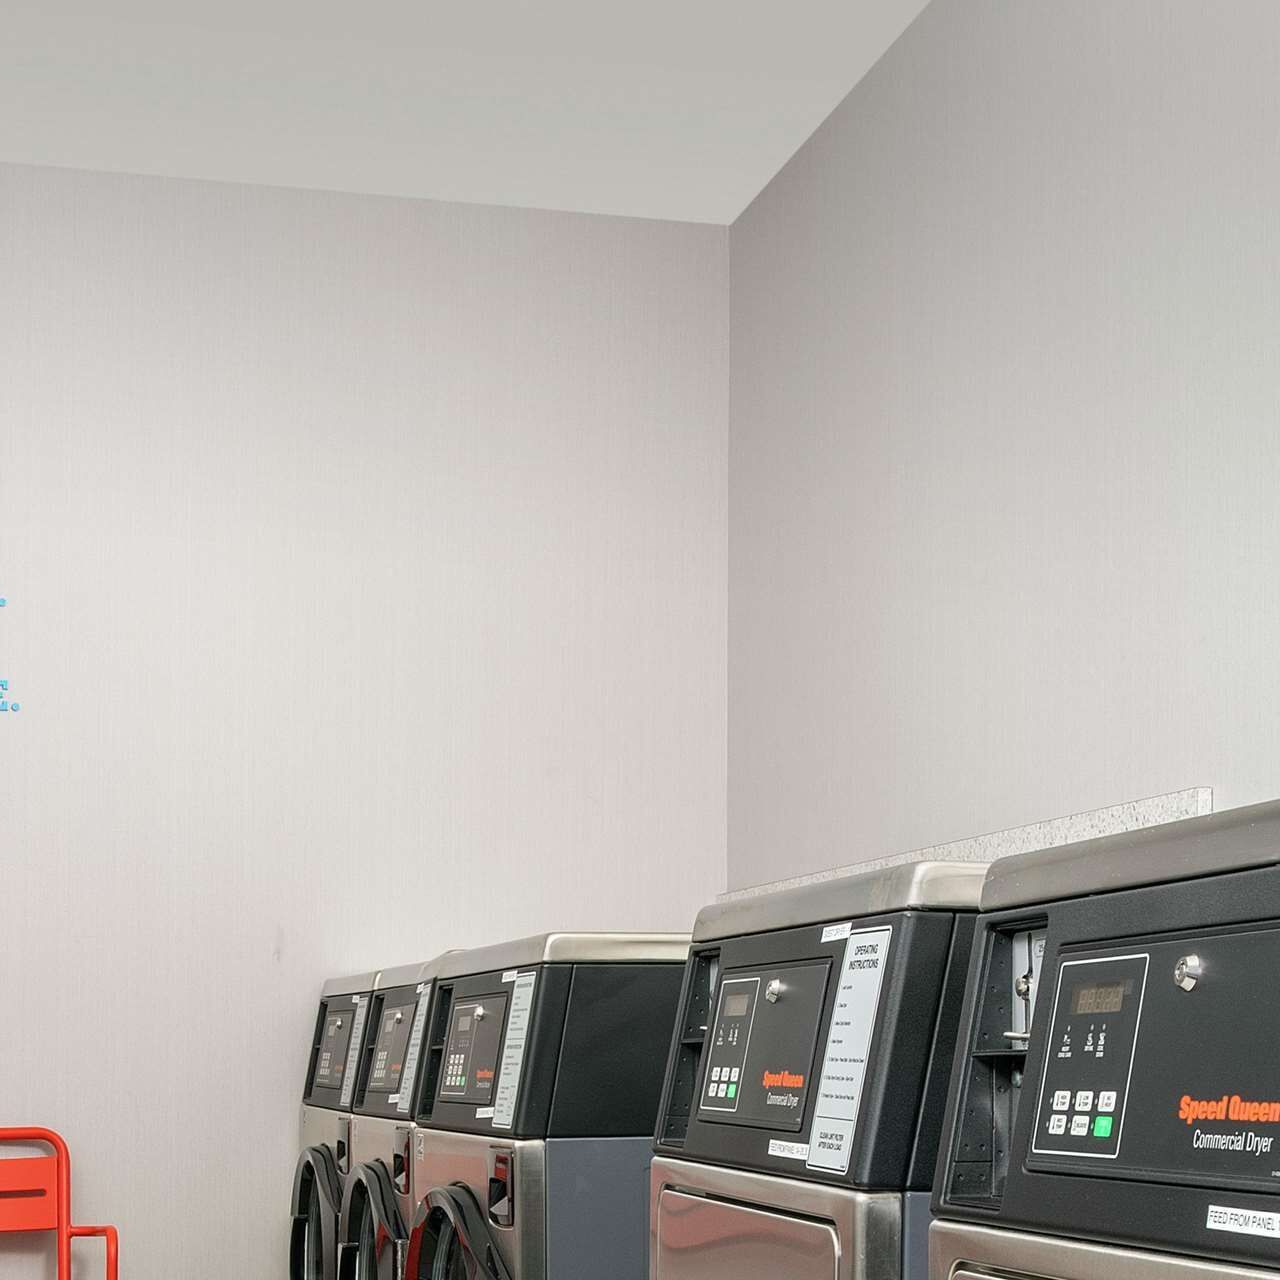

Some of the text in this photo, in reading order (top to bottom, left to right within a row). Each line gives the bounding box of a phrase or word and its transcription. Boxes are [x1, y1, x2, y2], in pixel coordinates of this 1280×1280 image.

[1179, 1095, 1228, 1125] Speed
[1193, 1129, 1274, 1156] Commercial Dryer
[1209, 1210, 1228, 1225] FEED
[1229, 1212, 1250, 1227] FROM
[1251, 1215, 1276, 1231] PANEL
